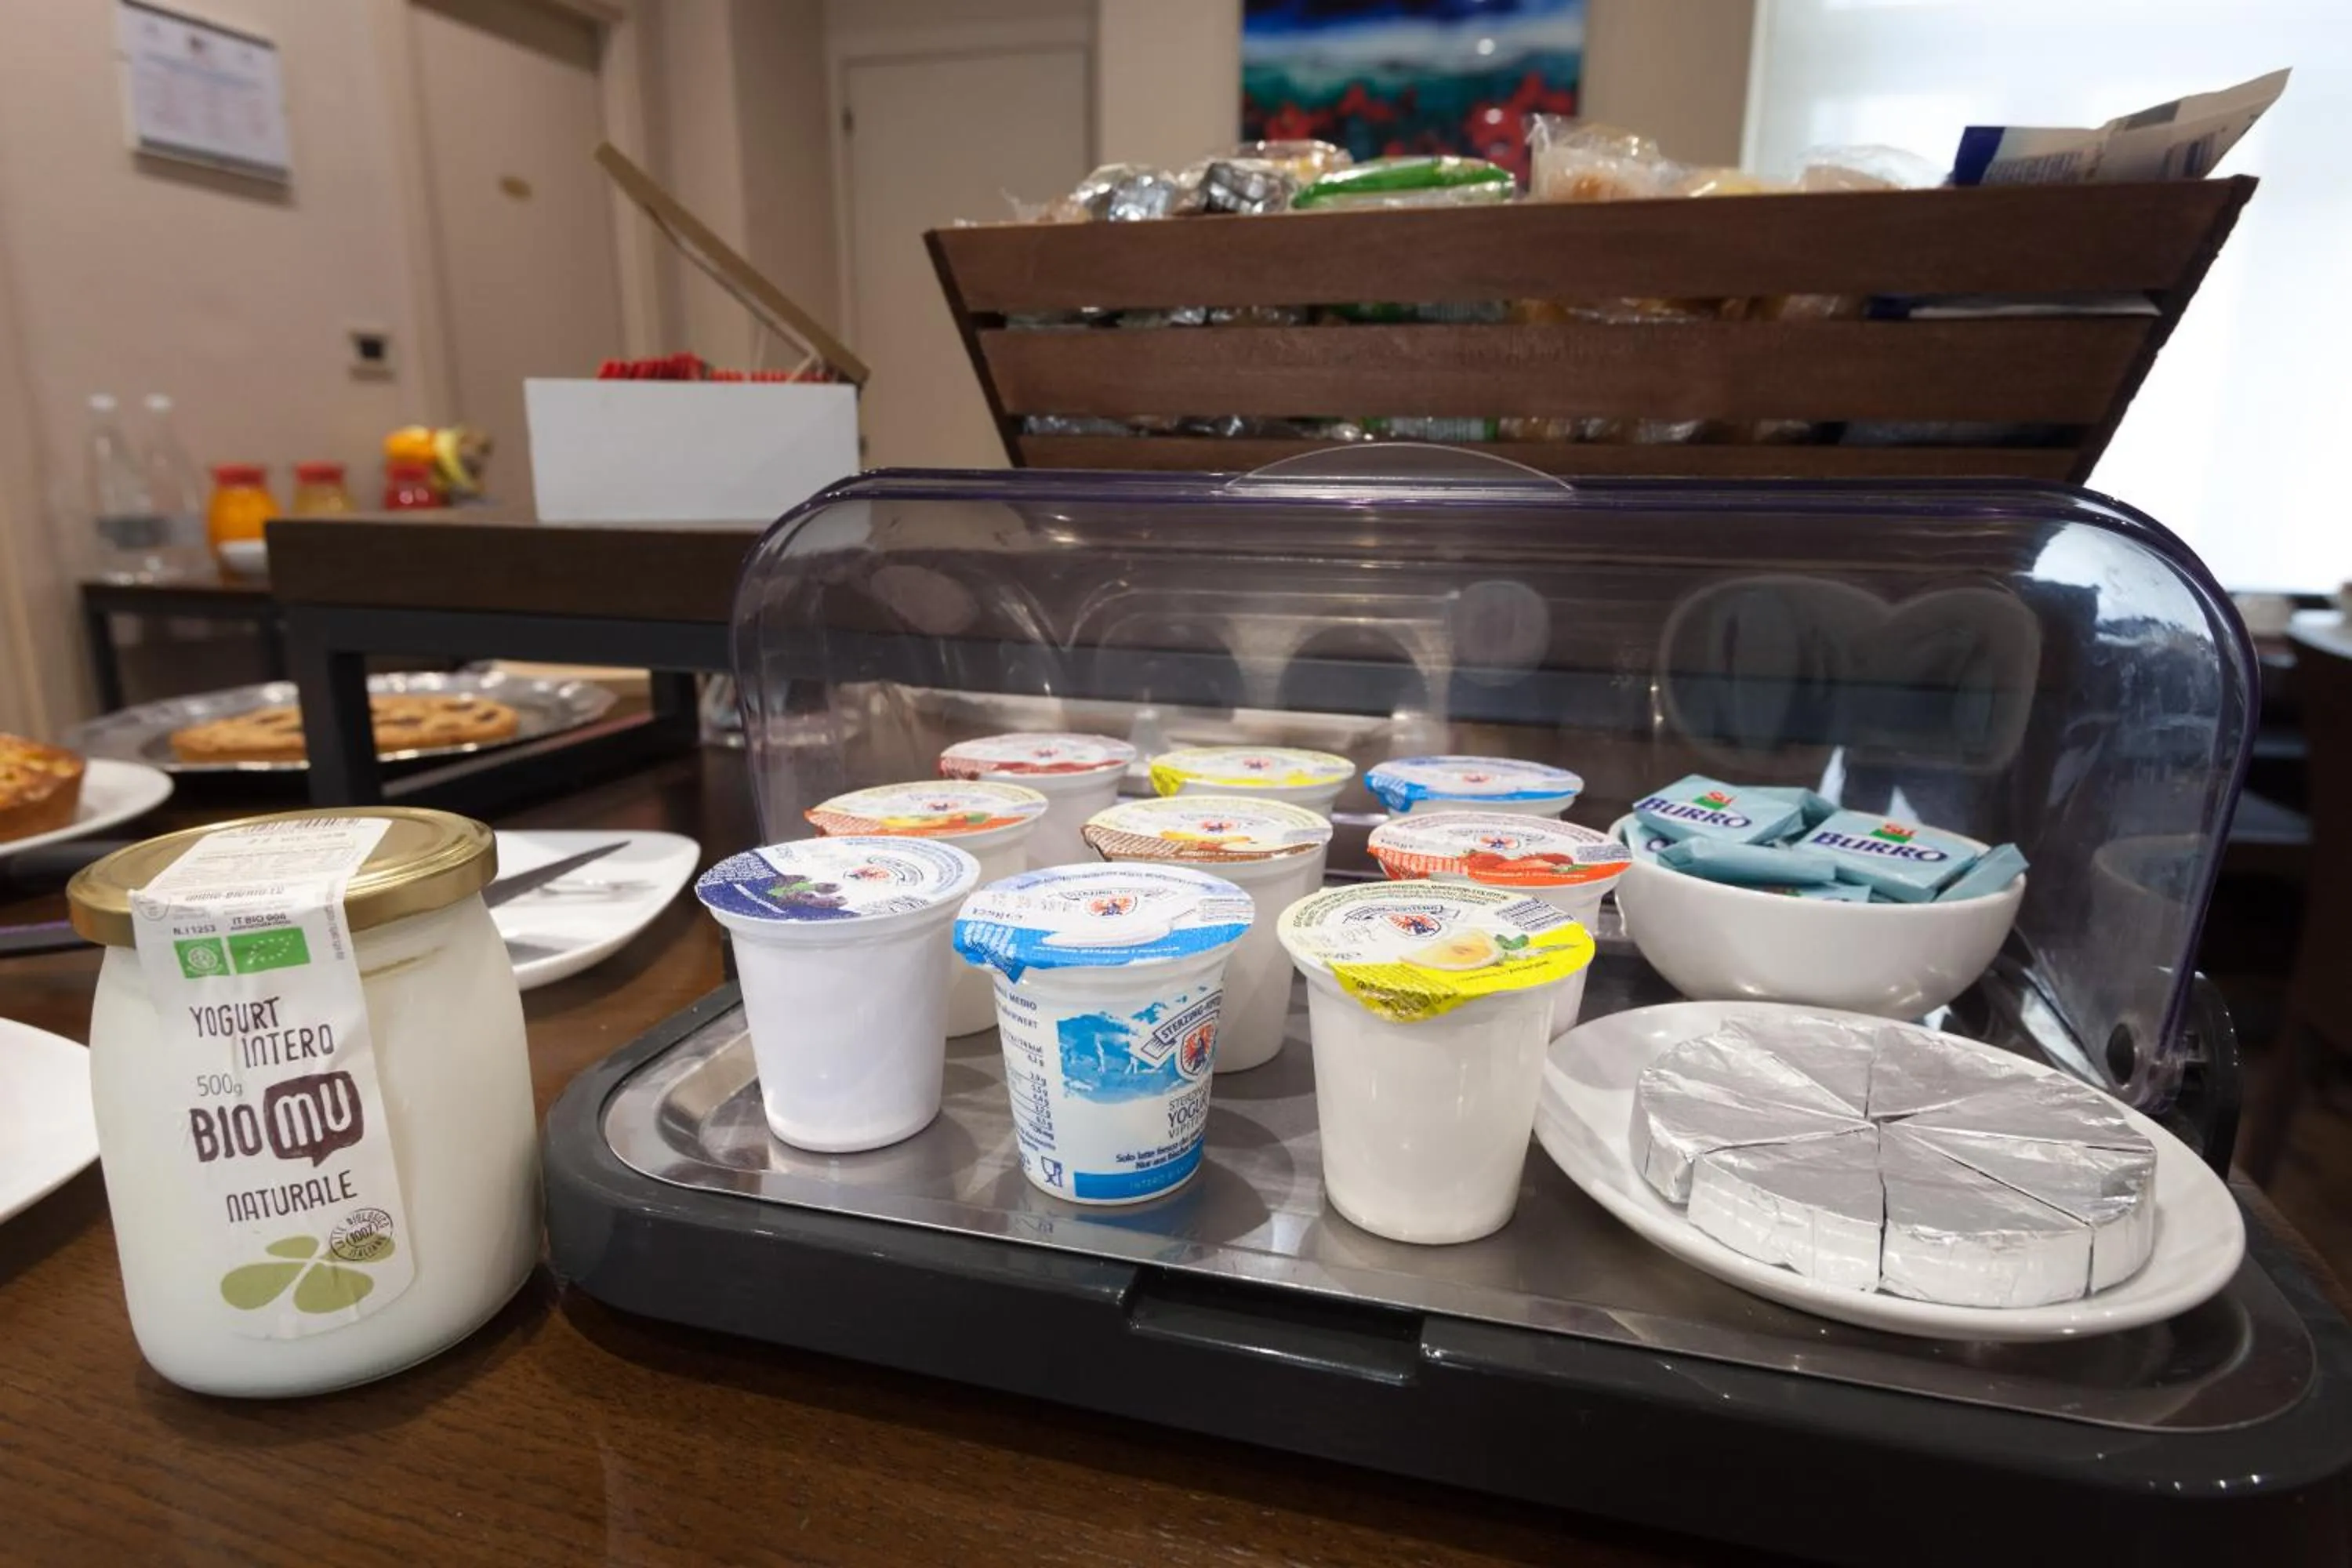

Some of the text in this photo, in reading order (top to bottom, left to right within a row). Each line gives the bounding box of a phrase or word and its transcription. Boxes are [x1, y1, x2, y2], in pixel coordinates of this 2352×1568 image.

[1639, 797, 1753, 828] BURRO
[1812, 832, 1949, 862] BURRO
[189, 996, 280, 1037] YOGURT
[241, 1024, 334, 1068] INTERO
[197, 1073, 243, 1096] 500g
[227, 1170, 358, 1223] NATURALE
